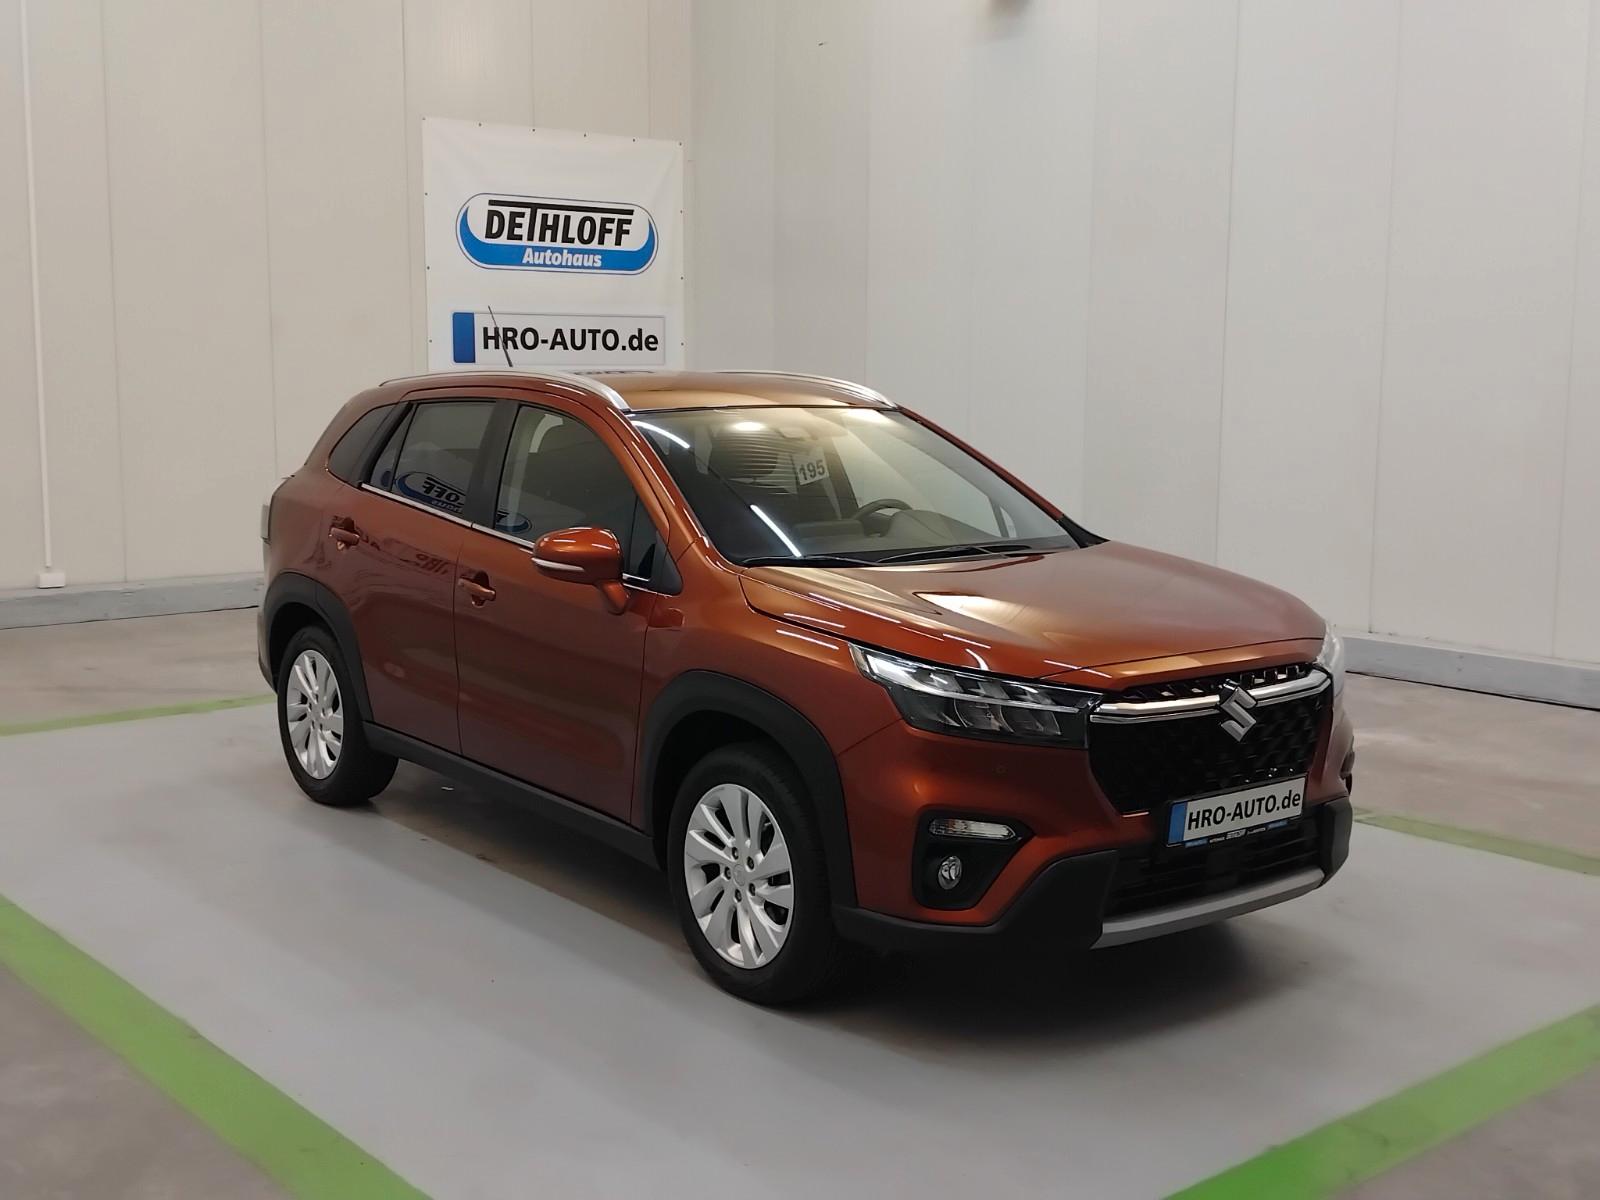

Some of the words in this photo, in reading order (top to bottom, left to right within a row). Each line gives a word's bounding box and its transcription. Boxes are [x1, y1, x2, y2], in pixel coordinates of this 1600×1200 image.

[485, 200, 635, 246] DETHLOFF
[522, 248, 602, 267] Autohaus
[483, 327, 659, 352] HRO-AUTO.de
[799, 459, 825, 480] 195
[1187, 789, 1301, 831] HRO-AUTO.de
